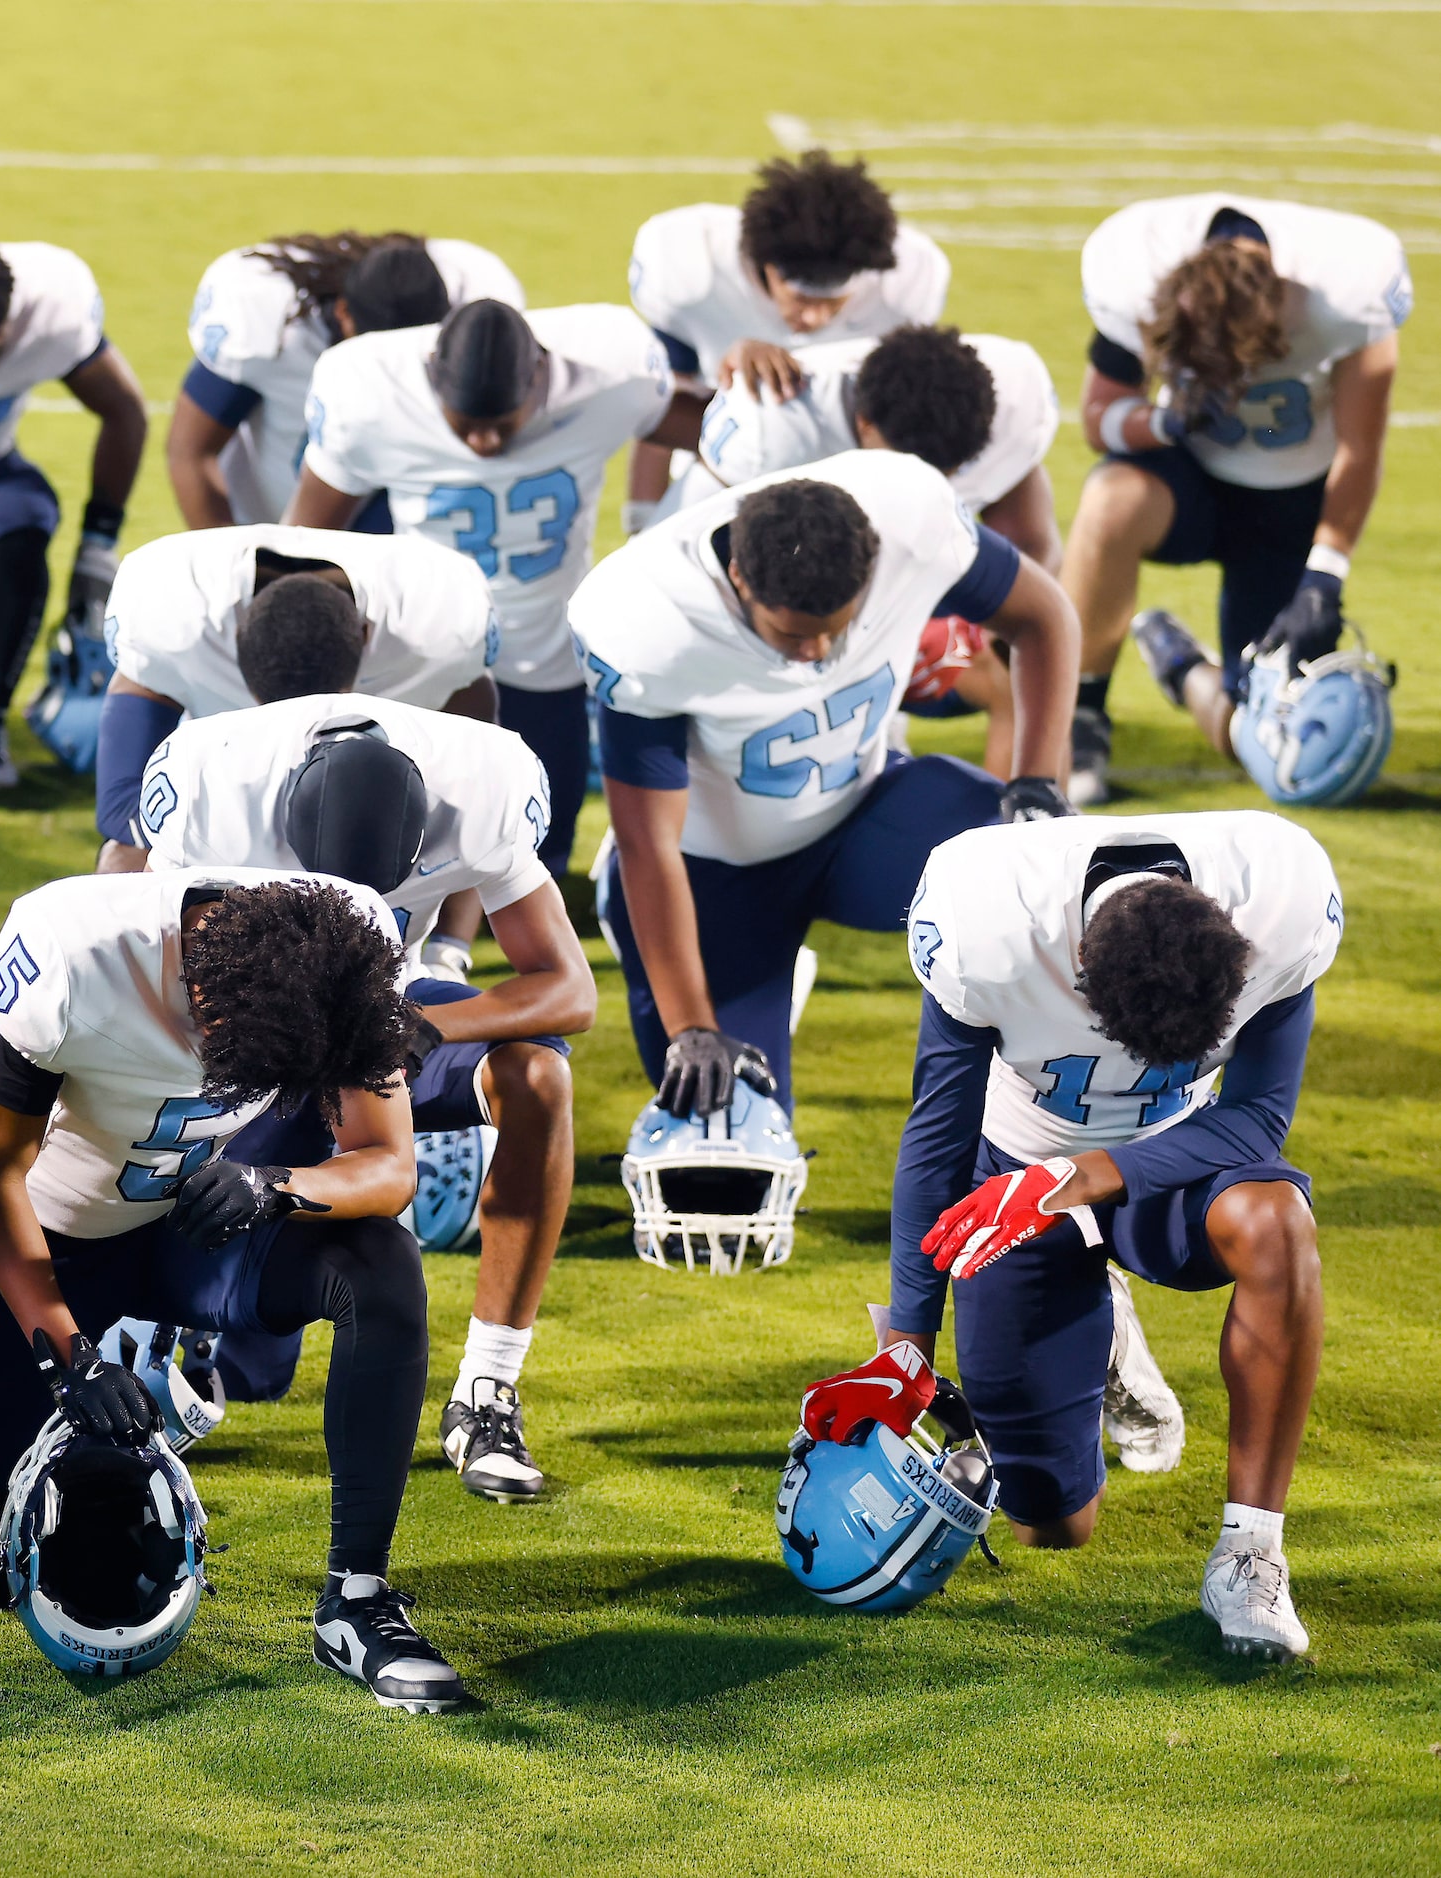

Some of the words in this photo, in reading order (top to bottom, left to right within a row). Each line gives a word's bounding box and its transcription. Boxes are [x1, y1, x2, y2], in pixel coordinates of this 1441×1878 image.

[425, 468, 578, 584] 33
[1033, 1054, 1200, 1128] 14
[116, 1097, 223, 1202] 5
[902, 1455, 985, 1530] MAVERICKS
[60, 1622, 175, 1661] MAVERICKS
